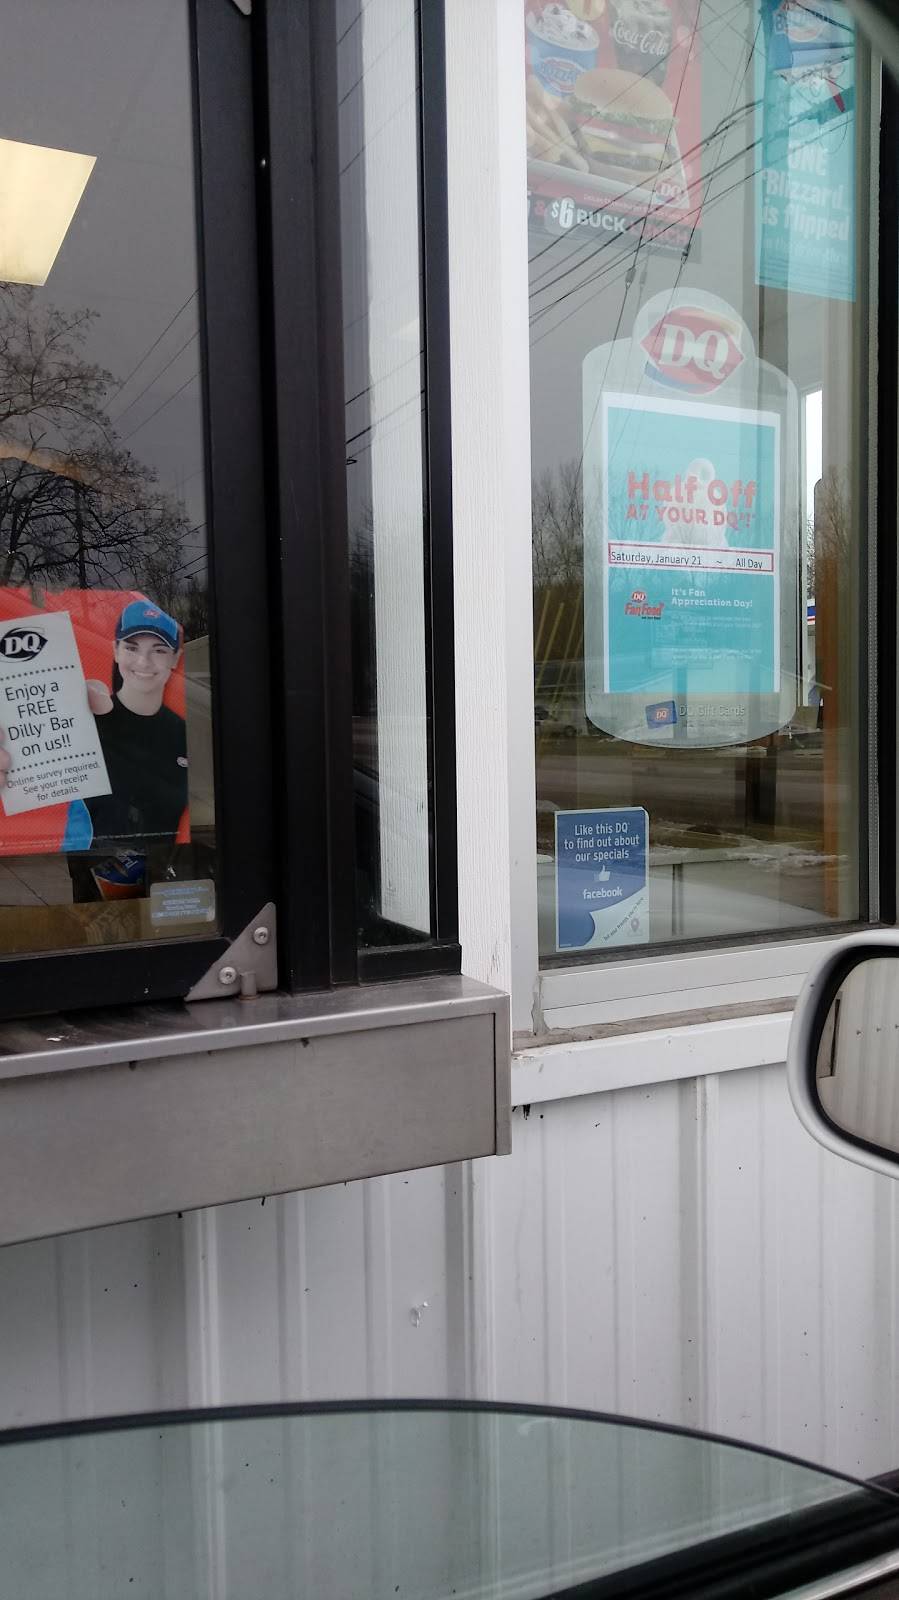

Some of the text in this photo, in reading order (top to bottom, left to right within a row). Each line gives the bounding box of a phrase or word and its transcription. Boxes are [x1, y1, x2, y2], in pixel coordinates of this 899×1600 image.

[576, 208, 626, 233] BUCK
[657, 323, 730, 380] DQ
[627, 471, 757, 509] Half Off
[625, 503, 649, 521] AT
[656, 505, 709, 526] YOUR
[610, 551, 653, 564] Saturday,
[655, 554, 690, 566] January
[691, 555, 702, 566] 21
[735, 558, 746, 568] All
[747, 560, 763, 569] Day
[688, 589, 706, 597] Fan
[671, 597, 753, 608] Appreciation Day!
[4, 632, 42, 656] DQ
[5, 681, 60, 701] Enjoy a
[17, 698, 57, 719] FREE
[50, 716, 75, 732] Bar
[21, 734, 72, 757] on us!!
[23, 773, 88, 795] See your receipt
[36, 769, 63, 781] survey
[37, 793, 49, 801] for
[575, 822, 629, 836] Like this DQ
[564, 834, 640, 850] to find out about
[575, 848, 629, 862] our specials
[582, 887, 623, 900] facebook
